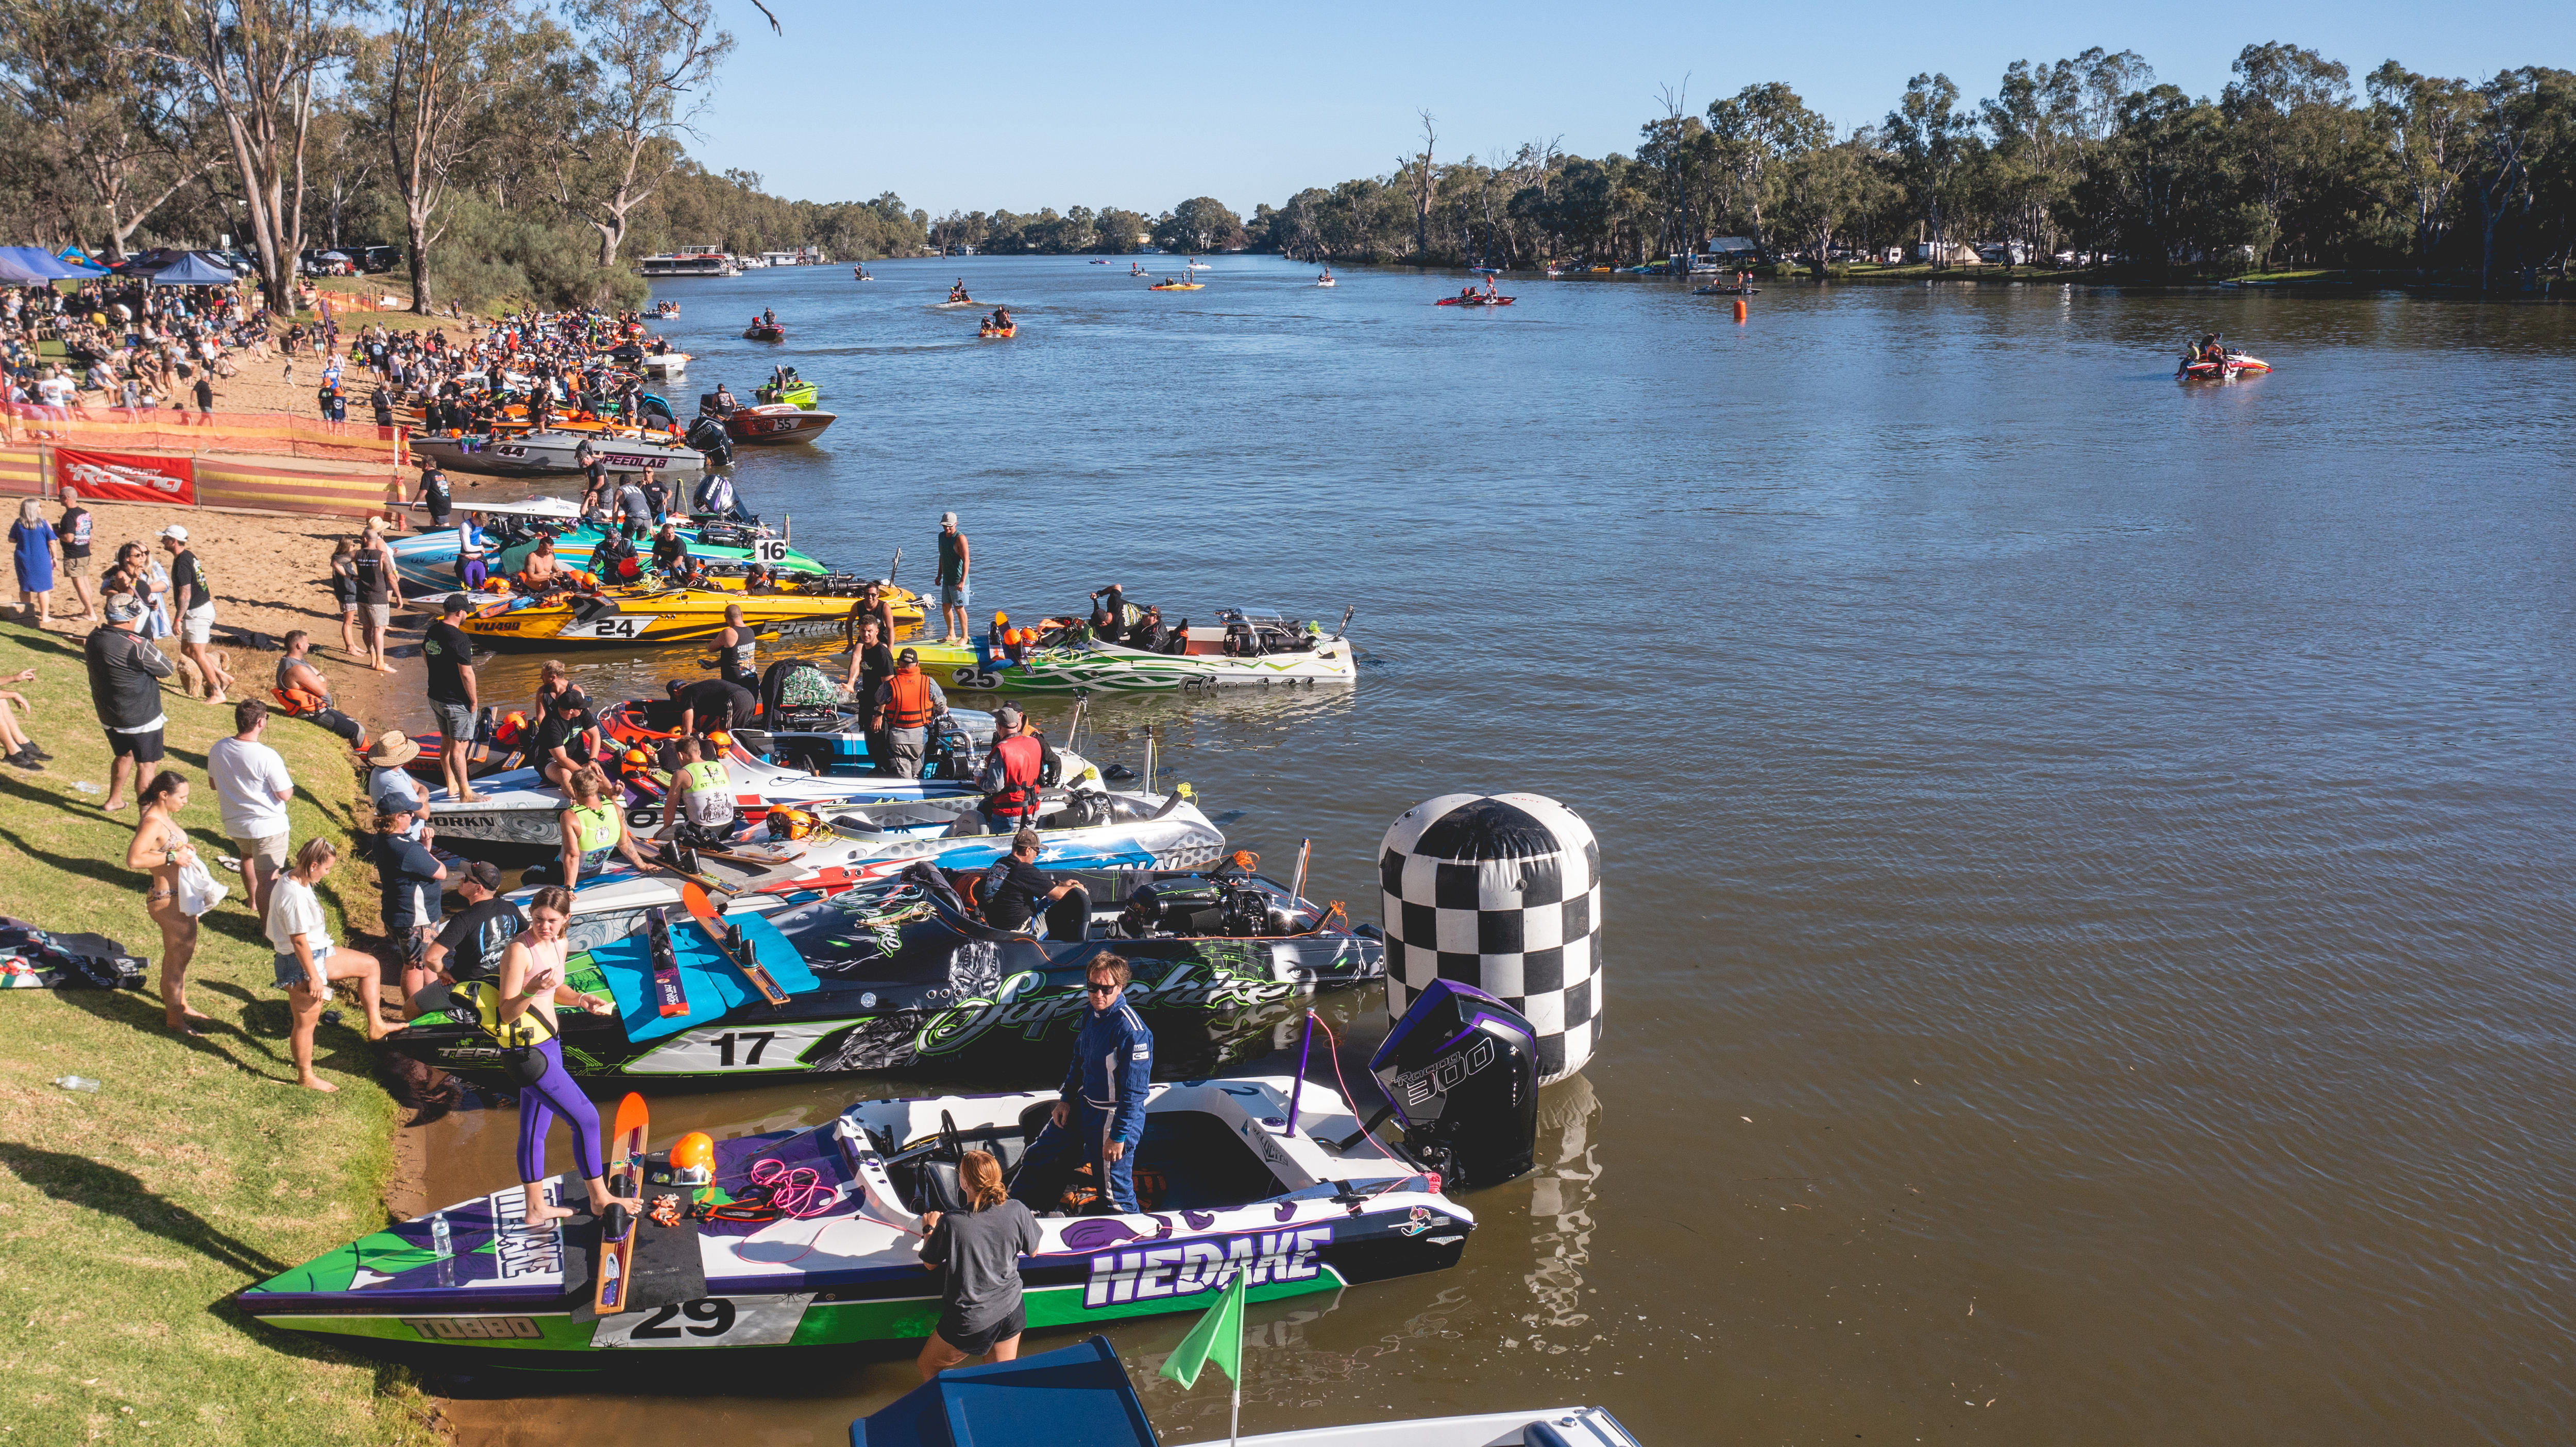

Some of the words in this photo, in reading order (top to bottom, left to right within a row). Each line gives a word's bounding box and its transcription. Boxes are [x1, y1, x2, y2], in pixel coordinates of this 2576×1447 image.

[777, 419, 791, 429] 55
[499, 446, 526, 457] 44
[104, 465, 162, 475] MERCURY
[599, 455, 668, 468] PEEDLAB
[68, 464, 183, 492] Racing
[759, 542, 786, 560] 16
[474, 622, 520, 632] VU499
[595, 619, 635, 638] 24
[956, 668, 996, 688] 25
[711, 1032, 775, 1066] 17
[1392, 1051, 1461, 1087] Racing
[1408, 1037, 1495, 1106] 300
[1083, 1223, 1334, 1309] HEDAKE
[631, 1298, 736, 1339] 29
